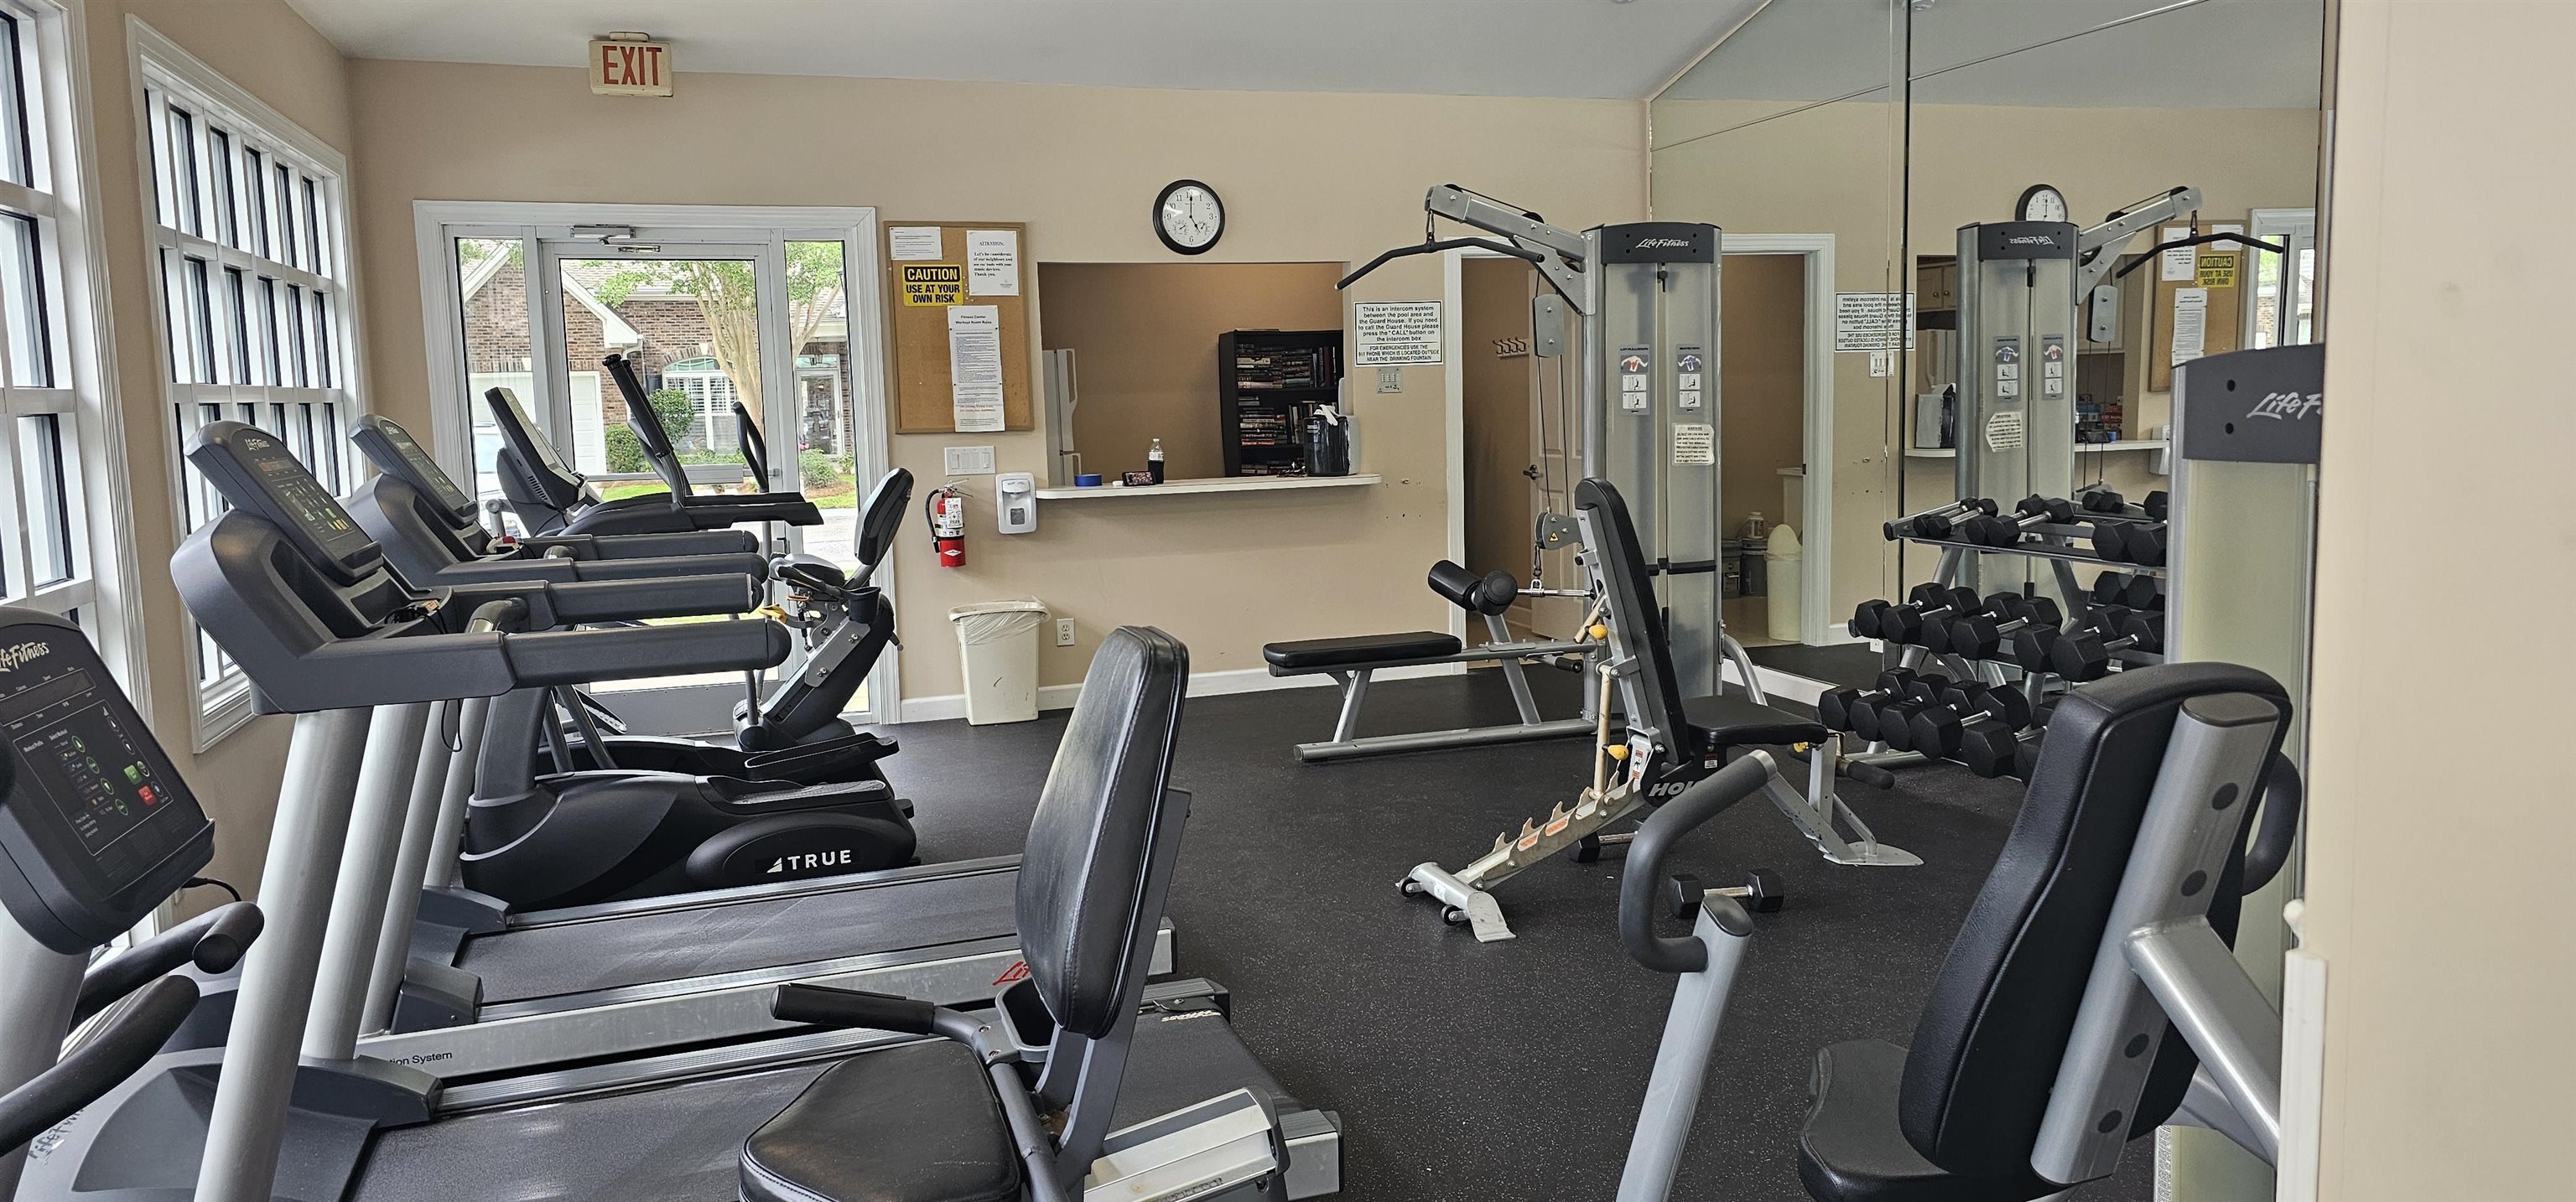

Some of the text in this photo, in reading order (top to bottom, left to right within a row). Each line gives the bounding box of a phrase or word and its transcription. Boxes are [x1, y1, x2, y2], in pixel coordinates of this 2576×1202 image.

[602, 45, 662, 85] EXIT
[1635, 238, 1690, 249] Life Fitness
[907, 268, 958, 281] CAUTION
[906, 284, 960, 293] USE AT YOUR
[912, 294, 955, 303] OWN RISK
[2246, 391, 2302, 420] Life
[9, 641, 50, 670] Fitness
[787, 849, 851, 870] TRUE
[412, 1052, 453, 1065] System
